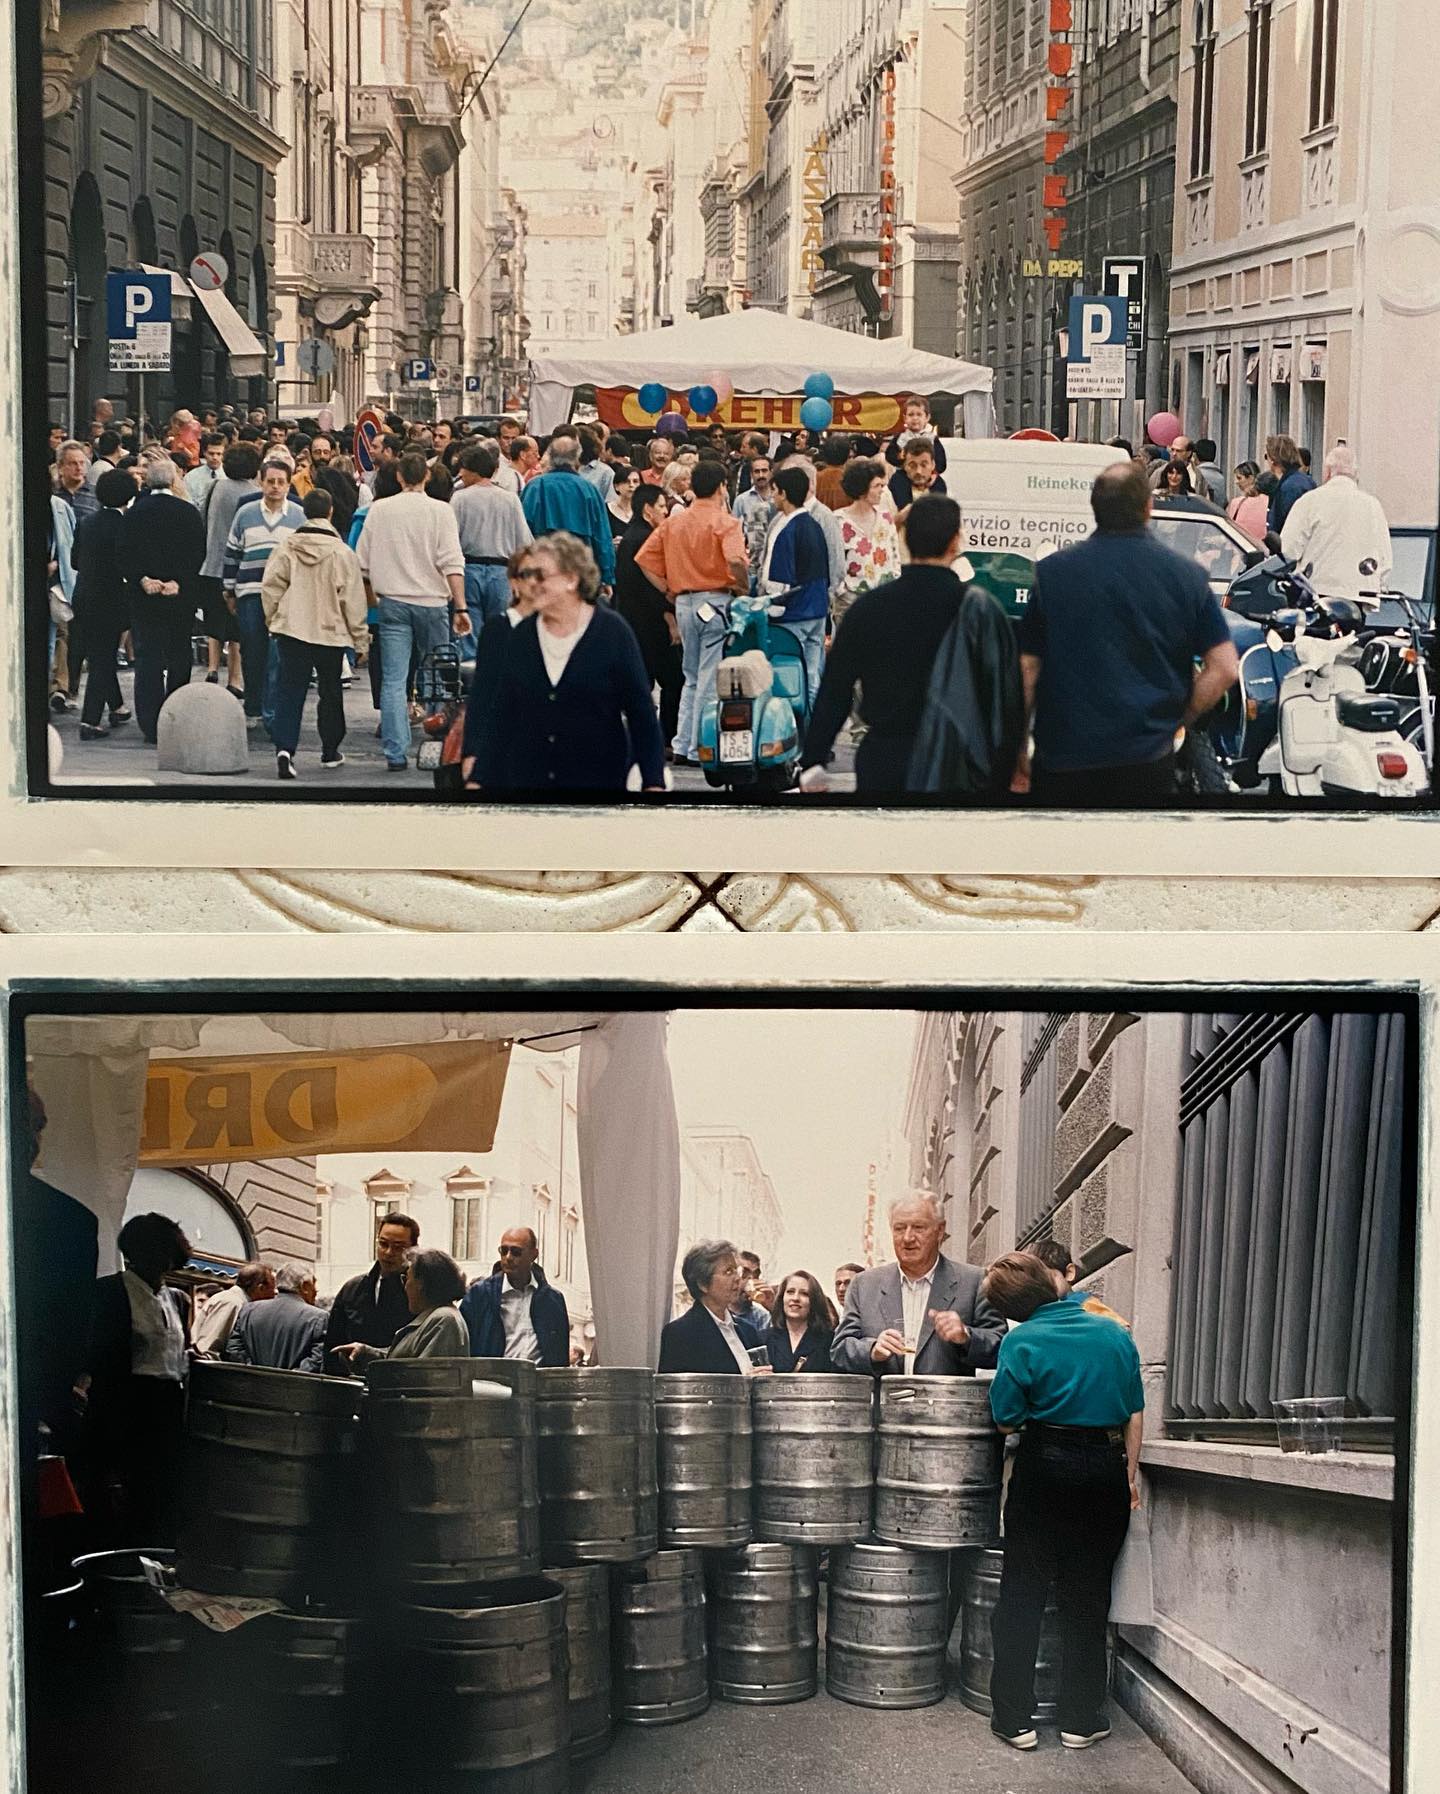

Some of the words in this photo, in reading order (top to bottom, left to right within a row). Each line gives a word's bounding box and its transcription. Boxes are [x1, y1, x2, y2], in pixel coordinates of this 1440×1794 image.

[1042, 0, 1073, 252] BUFFET
[1023, 260, 1042, 278] DA
[125, 285, 153, 327] P
[1082, 303, 1112, 358] P
[412, 361, 427, 378] P
[963, 515, 1010, 531] rvizio
[1020, 517, 1088, 534] tecnico
[968, 532, 1031, 548] stenza
